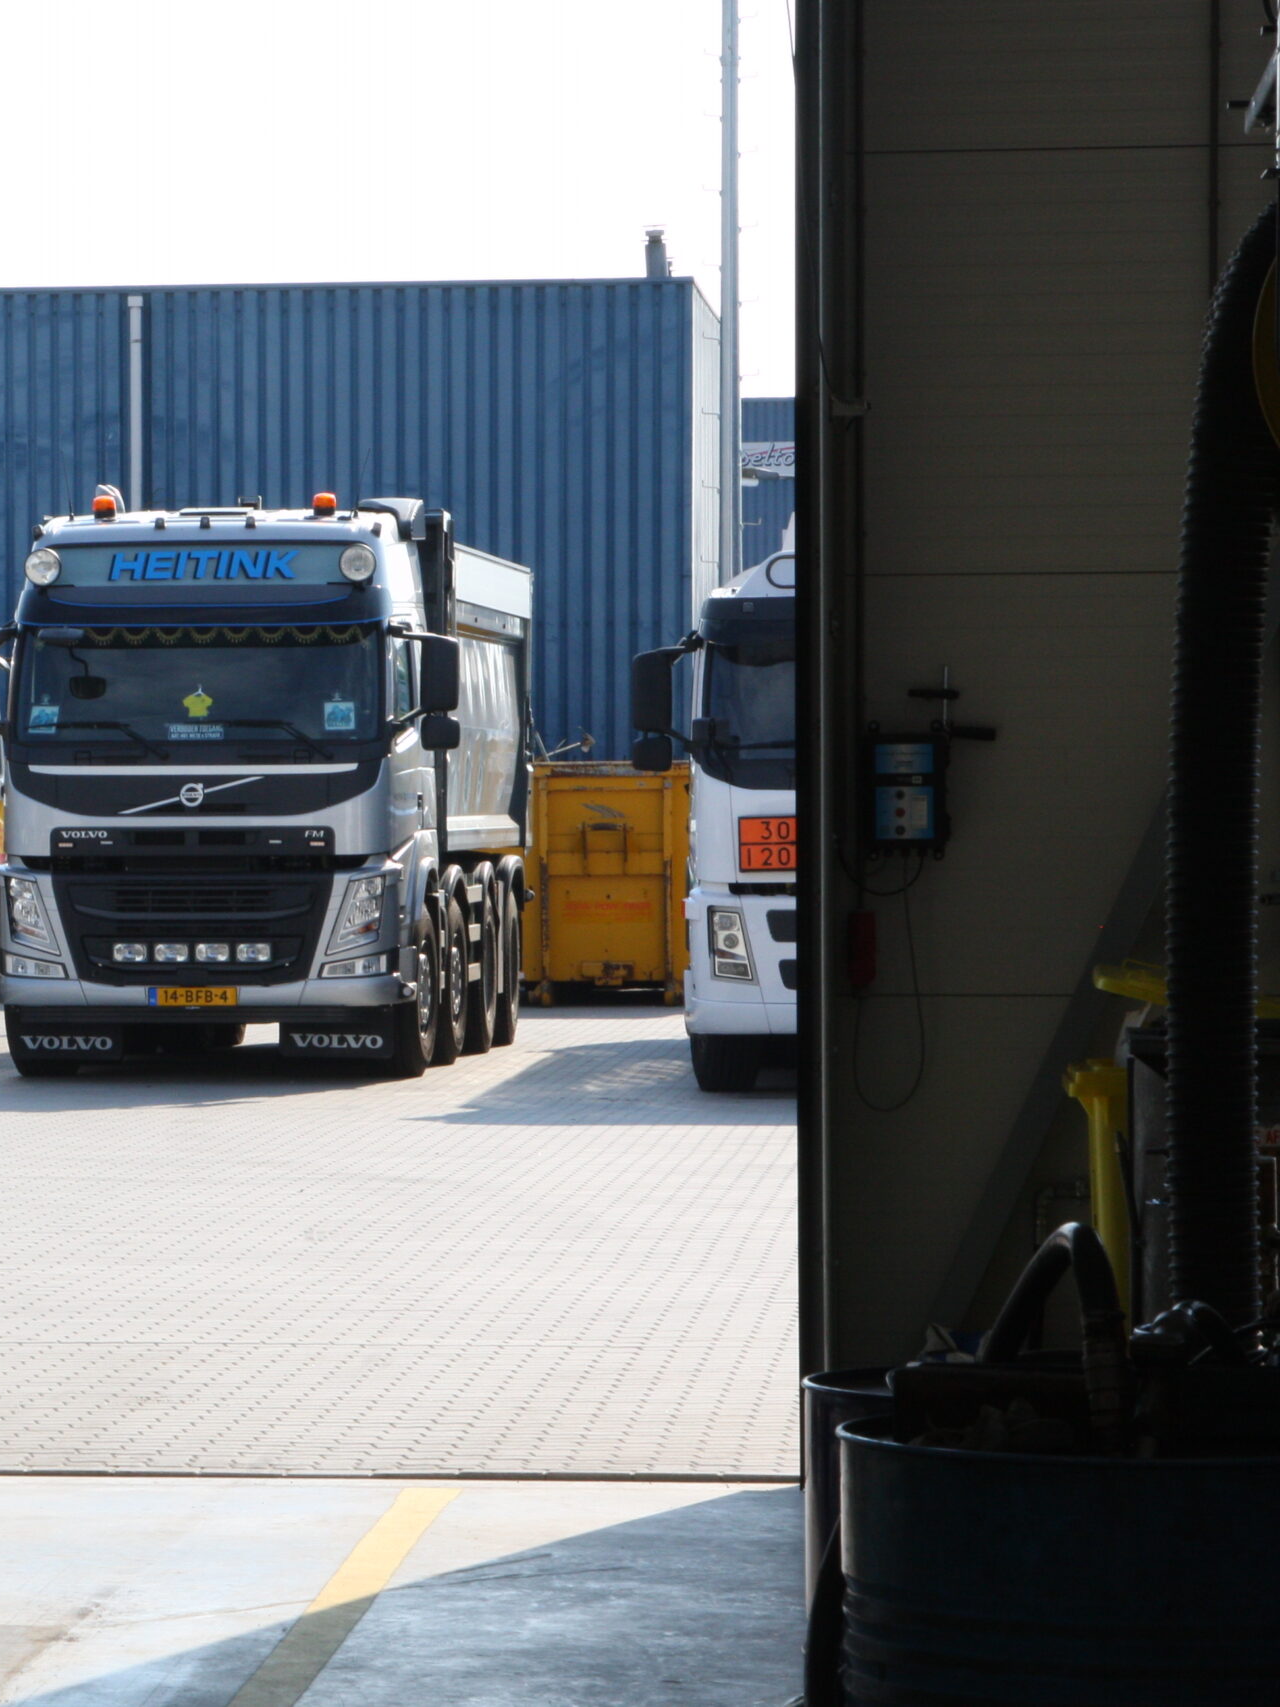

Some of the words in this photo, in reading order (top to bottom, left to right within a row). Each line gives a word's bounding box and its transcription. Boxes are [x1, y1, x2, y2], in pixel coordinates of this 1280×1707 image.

[109, 550, 300, 581] HEITINK
[61, 830, 108, 839] VOLVO
[305, 830, 324, 838] FM
[760, 821, 790, 840] 30
[162, 988, 229, 1003] 14-BFB-4
[21, 1035, 113, 1050] VOLVO
[290, 1033, 383, 1049] VOLVO
